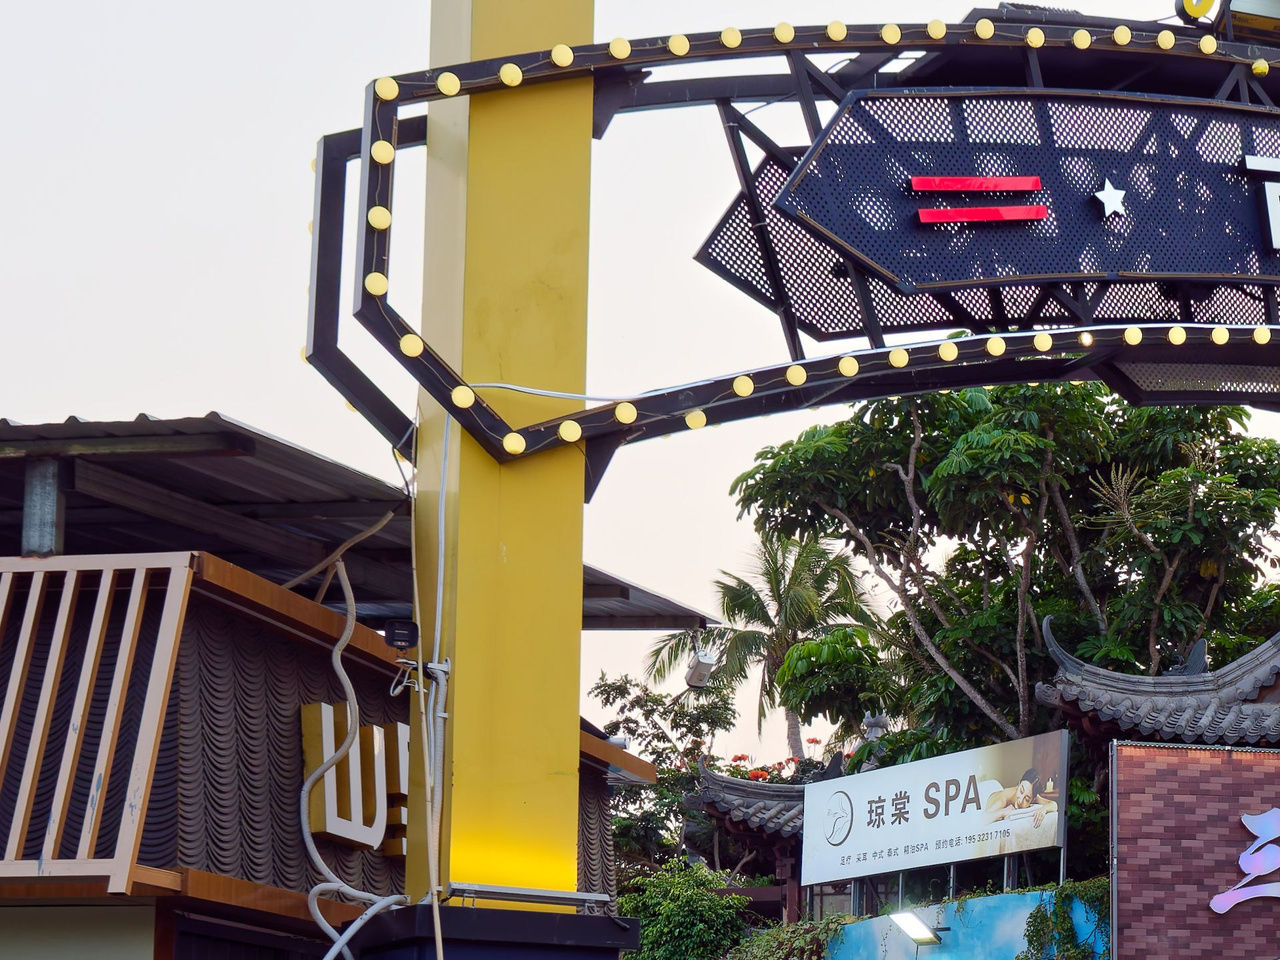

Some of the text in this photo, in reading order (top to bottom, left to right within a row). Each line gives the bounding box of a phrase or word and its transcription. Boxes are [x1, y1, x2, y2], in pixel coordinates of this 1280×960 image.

[867, 774, 982, 829] 琼棠 SPA
[965, 834, 977, 845] 195
[977, 831, 993, 843] 3231
[994, 828, 1011, 840] 7105
